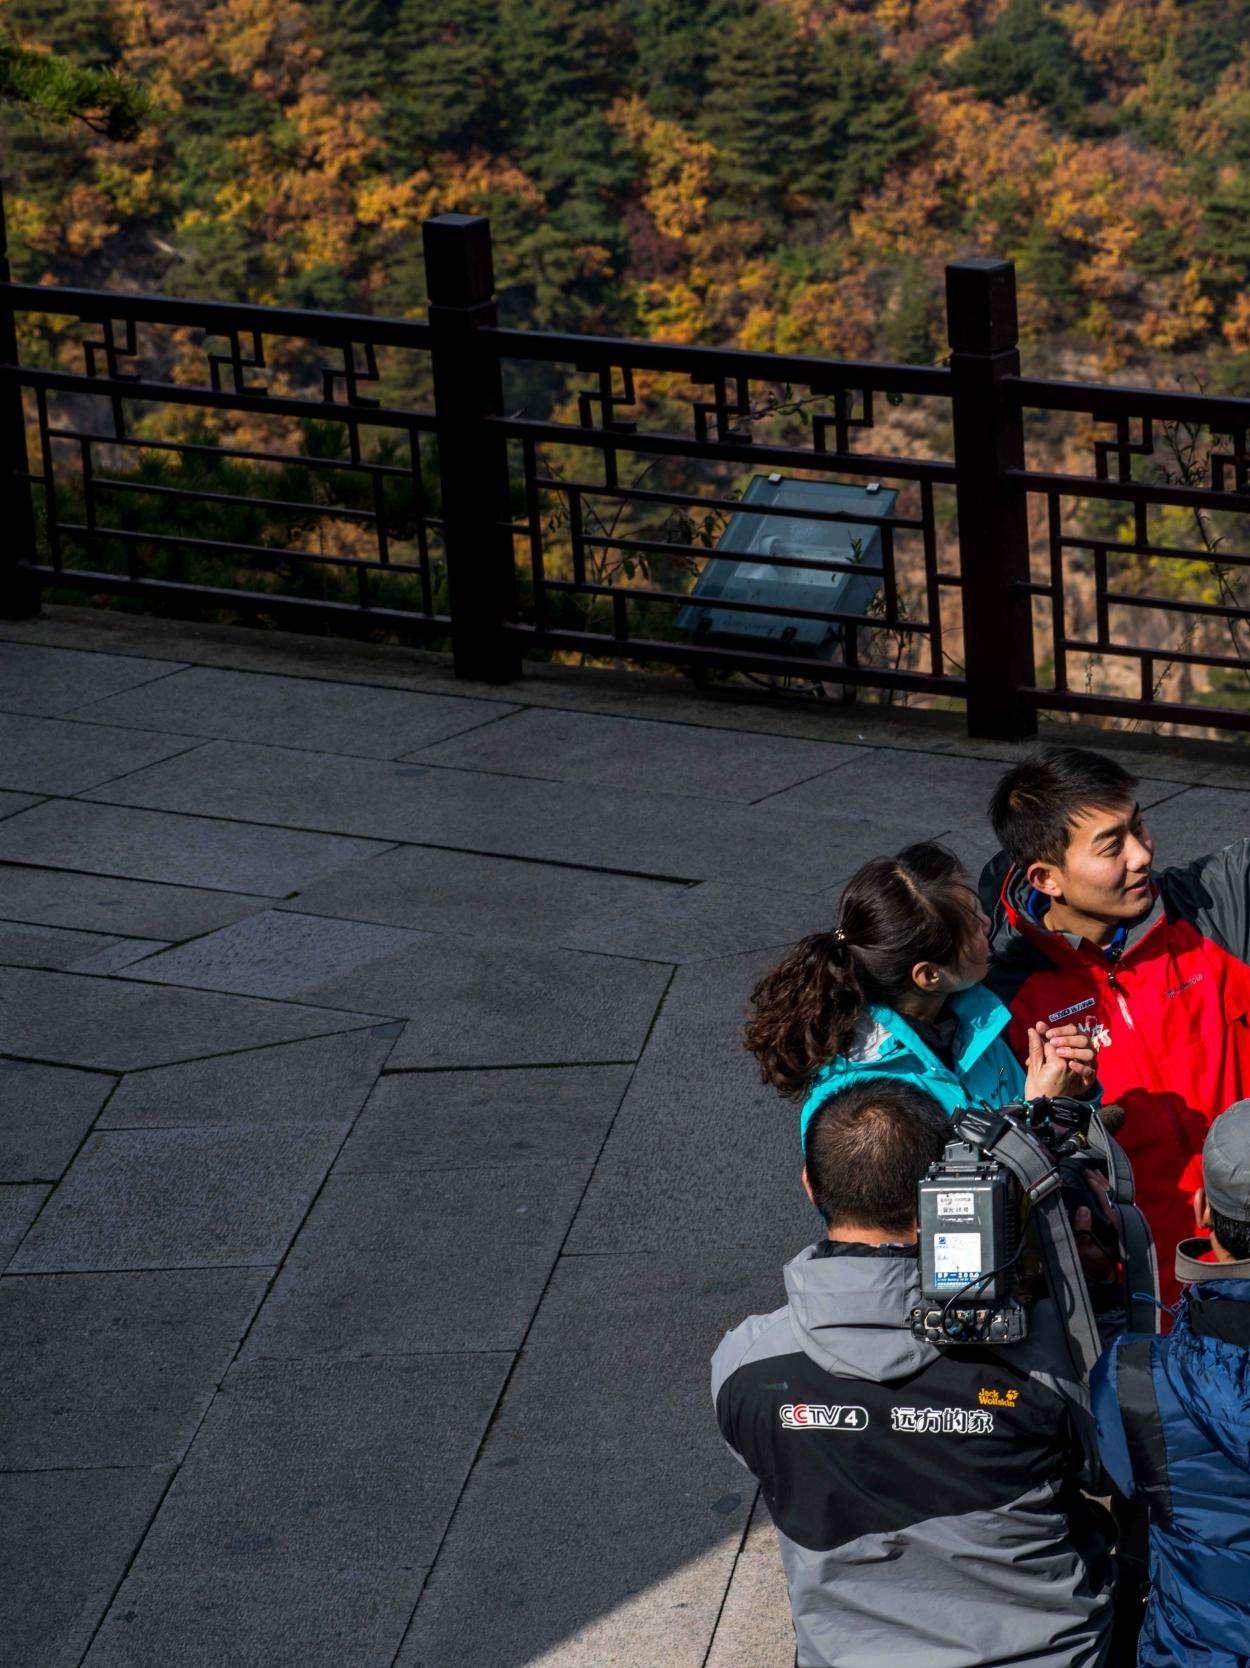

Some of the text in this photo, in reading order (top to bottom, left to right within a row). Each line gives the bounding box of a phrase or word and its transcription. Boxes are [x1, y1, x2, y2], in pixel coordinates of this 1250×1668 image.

[978, 1388, 999, 1399] Jack
[979, 1396, 1016, 1408] Wolfskin
[779, 1404, 840, 1424] CCTV
[891, 1406, 994, 1434] 远方的家
